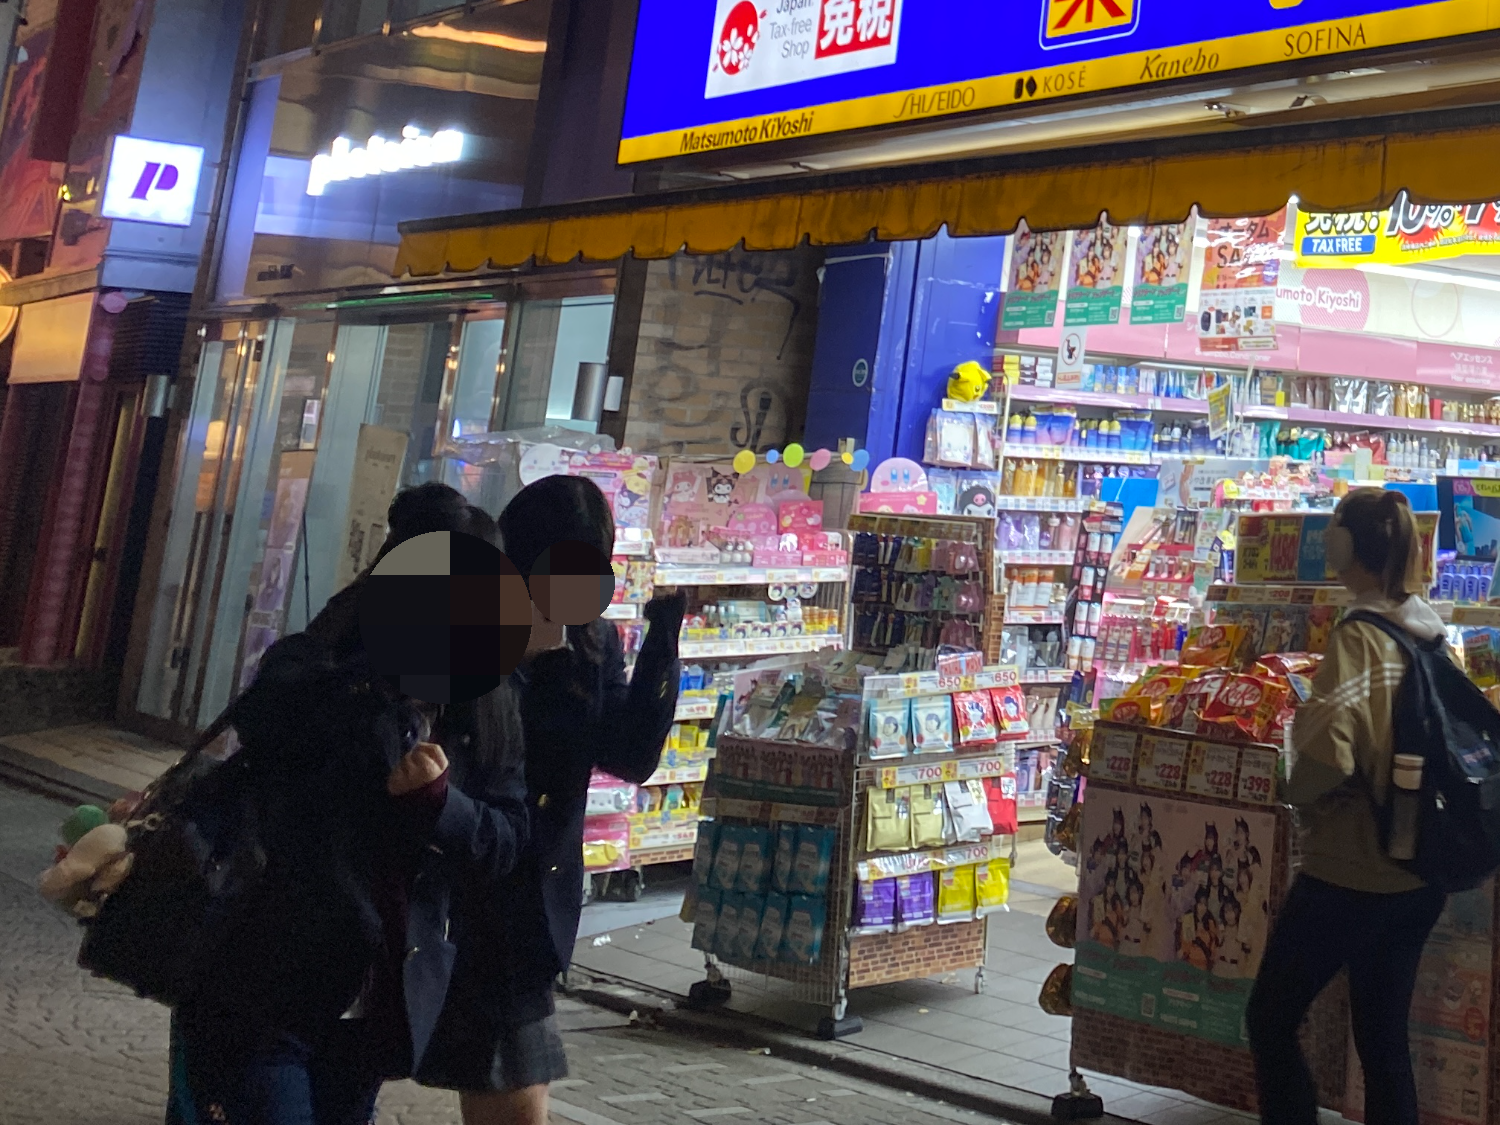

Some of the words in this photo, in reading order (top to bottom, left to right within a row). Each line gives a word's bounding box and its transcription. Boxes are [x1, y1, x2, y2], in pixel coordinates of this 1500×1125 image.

[769, 17, 813, 41] Tax-free
[1283, 22, 1368, 57] SOFINA
[781, 39, 810, 59] Shop
[1139, 47, 1220, 81] Kanebo
[893, 86, 976, 119] SHISEIDO
[680, 124, 757, 153] Matsumoto
[758, 111, 815, 136] KiYoshi
[128, 161, 180, 201] P
[1312, 238, 1335, 253] TAX
[1335, 237, 1363, 252] FREE
[1275, 286, 1315, 303] umoto
[1316, 288, 1360, 311] Kiyoshi
[1450, 351, 1493, 365] ヘアエッセンス
[1465, 634, 1489, 646] HARIBO
[938, 676, 961, 688] 650
[994, 671, 1017, 682] 650
[917, 767, 942, 778] 700
[977, 761, 1001, 772] 700
[964, 846, 988, 857] 700
